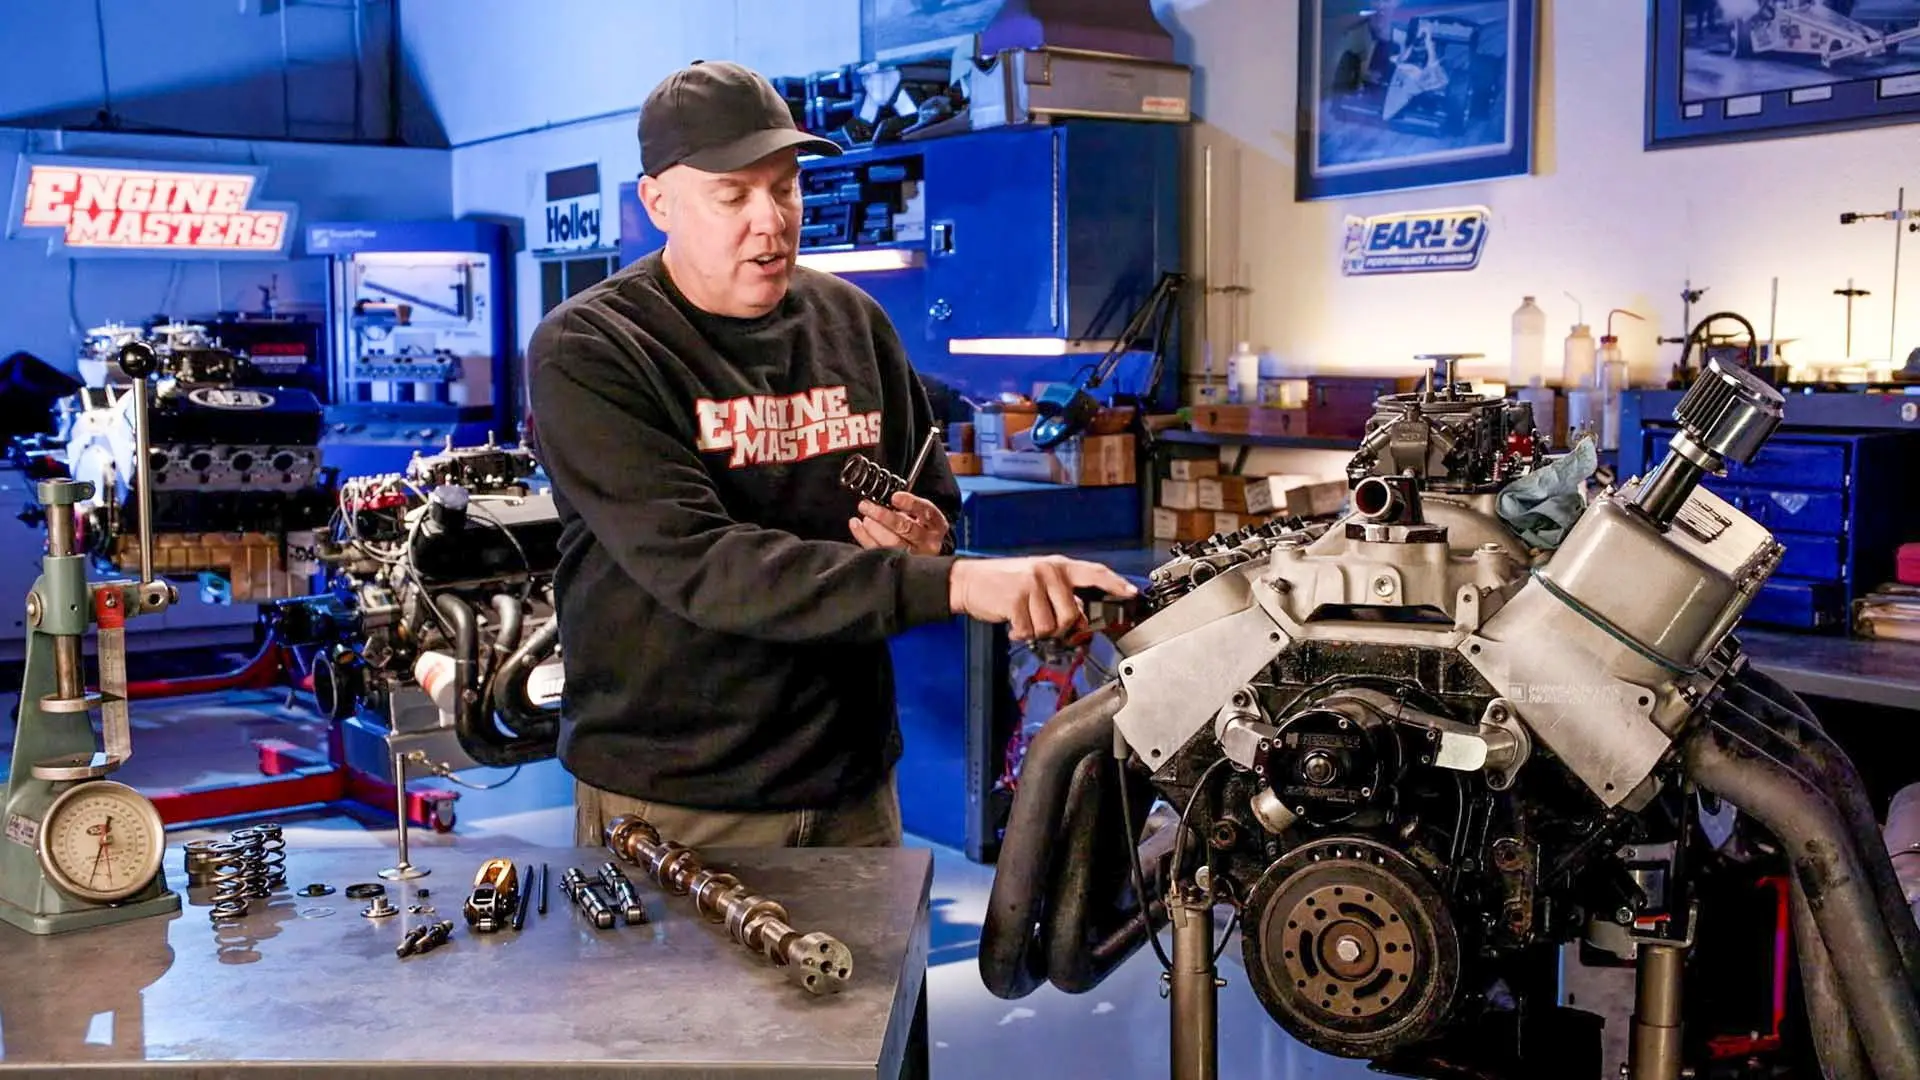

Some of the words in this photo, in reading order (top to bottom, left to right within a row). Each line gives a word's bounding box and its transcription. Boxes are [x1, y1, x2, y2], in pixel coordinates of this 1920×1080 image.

[26, 167, 249, 225] ENGINE
[66, 209, 281, 247] MASTERS
[546, 202, 600, 248] Holley
[1369, 216, 1478, 251] EARL'S
[696, 386, 849, 450] ENGINE
[729, 411, 882, 469] MASTERS
